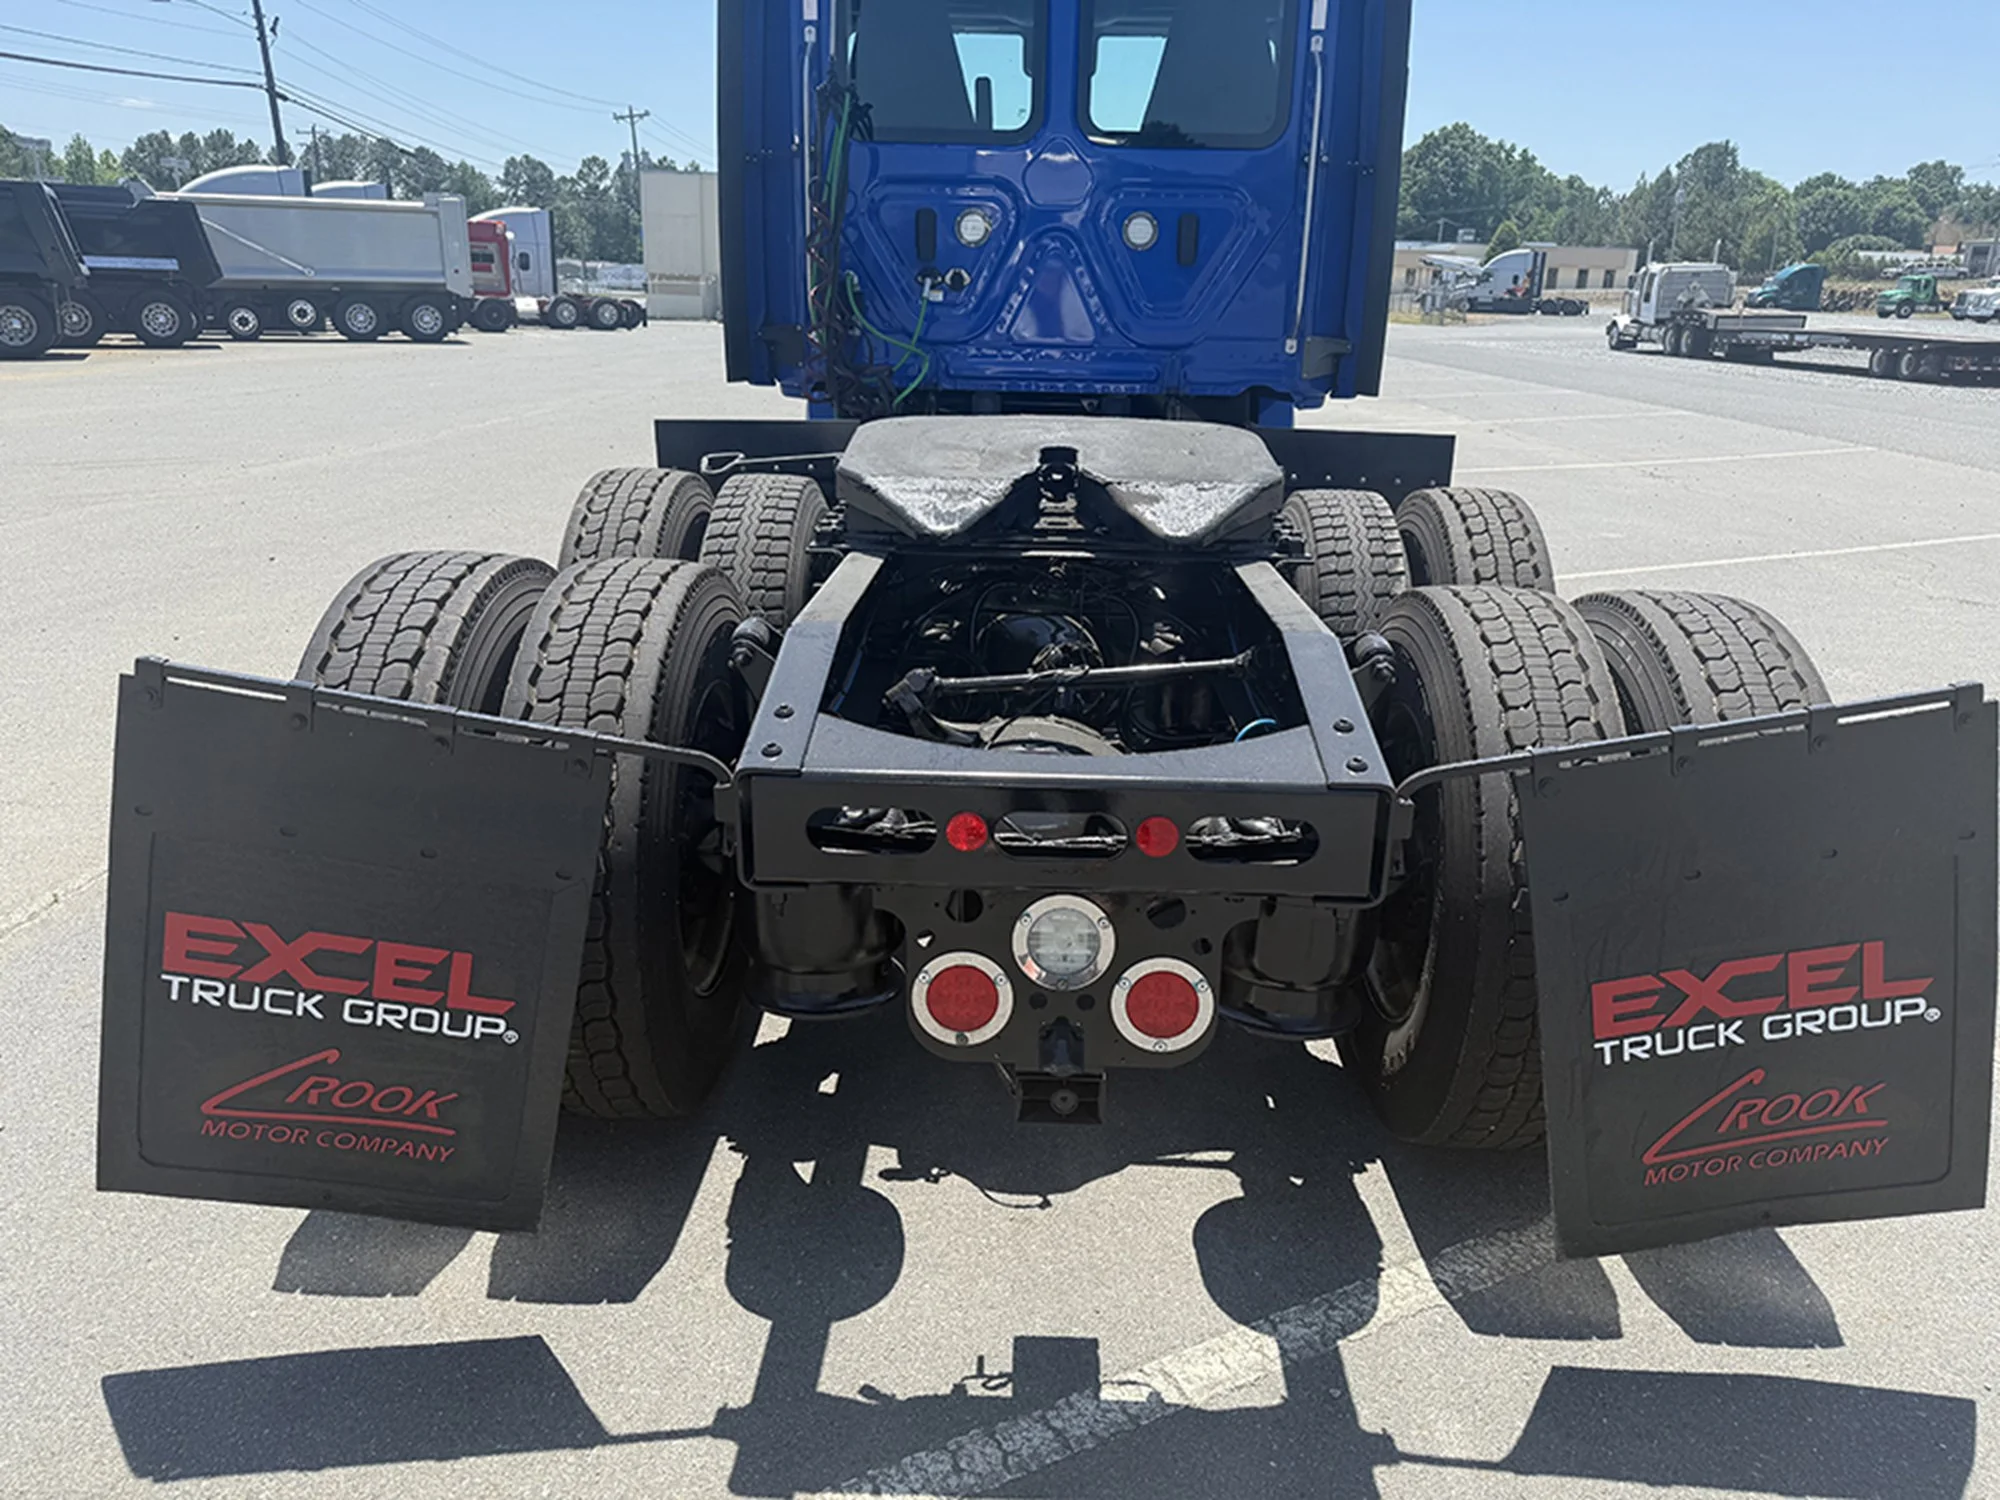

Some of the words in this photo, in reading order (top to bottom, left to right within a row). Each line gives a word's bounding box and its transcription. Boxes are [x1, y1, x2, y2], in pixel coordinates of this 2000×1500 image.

[160, 973, 324, 1020] TRUCK
[162, 911, 516, 1015] EXCEL
[1591, 940, 1935, 1040] EXCEL
[1593, 1019, 1745, 1066] TRUCK
[201, 1048, 458, 1136] CROOK
[1642, 1068, 1888, 1165] CROOK
[201, 1119, 310, 1144] MOTOR
[316, 1129, 455, 1162] COMPANY
[1643, 1155, 1743, 1186] MOTOR
[1748, 1138, 1889, 1170] COMPANY
